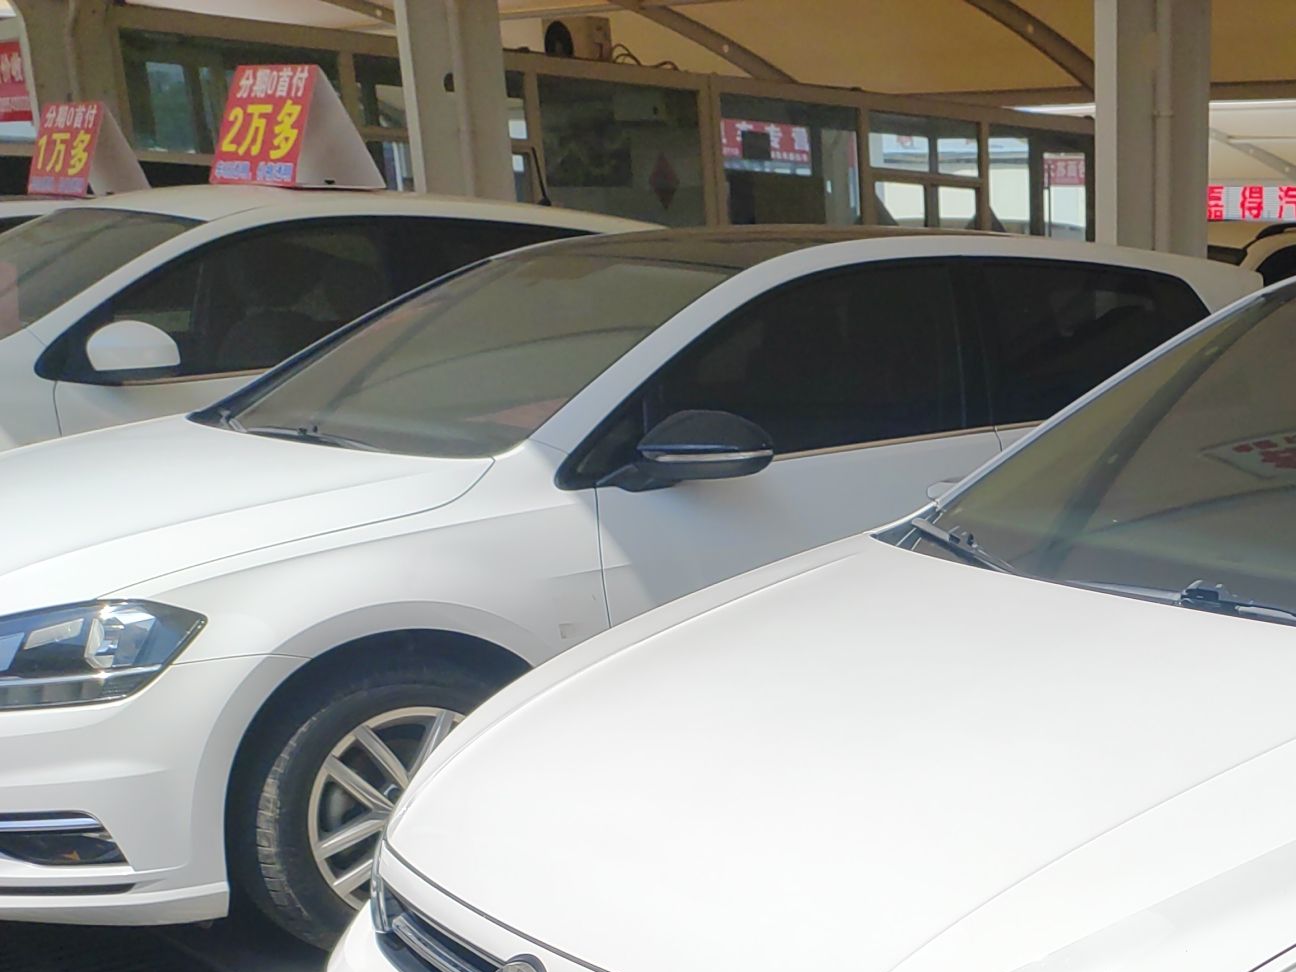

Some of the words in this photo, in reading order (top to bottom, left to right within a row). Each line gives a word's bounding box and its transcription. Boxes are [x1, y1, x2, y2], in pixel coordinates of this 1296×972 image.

[236, 66, 309, 99] 分期0首付
[44, 104, 97, 129] 分期0首付
[221, 99, 302, 160] 2万多
[37, 130, 92, 177] 1万多
